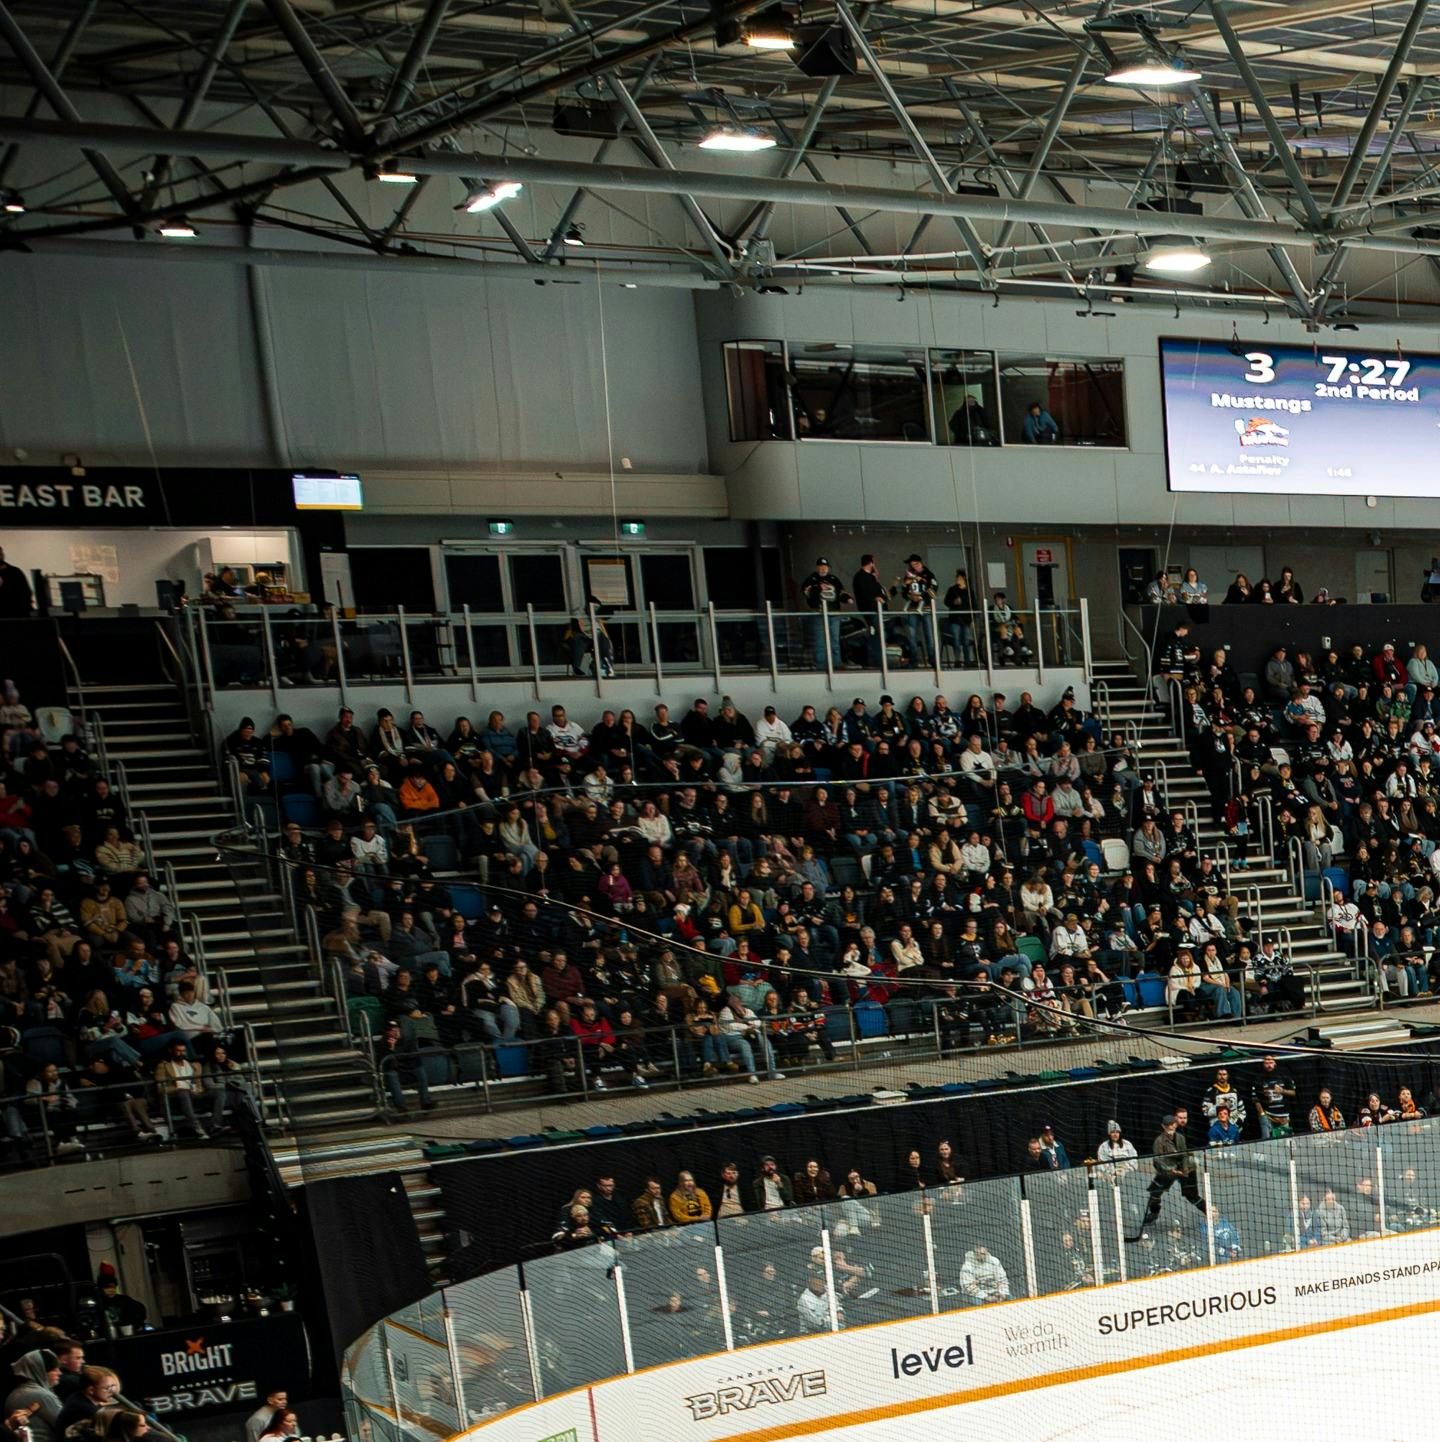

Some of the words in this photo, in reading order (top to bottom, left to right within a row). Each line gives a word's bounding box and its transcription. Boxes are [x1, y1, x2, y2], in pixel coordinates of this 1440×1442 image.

[1244, 352, 1275, 384] 3
[1322, 355, 1410, 386] 7:27
[1211, 393, 1311, 413] Mustangs
[1315, 382, 1353, 399] 2nd
[1357, 384, 1419, 402] Period
[84, 485, 145, 507] BAR
[1294, 1280, 1331, 1297] MAKE
[1332, 1271, 1381, 1291] BRANDS
[1383, 1263, 1421, 1281] STAND
[1098, 1286, 1277, 1335] SUPERCURIOUS
[1003, 1325, 1029, 1343] We
[1032, 1321, 1054, 1337] do
[1004, 1333, 1069, 1358] warmth
[161, 1343, 233, 1376] BRIGHT
[891, 1335, 974, 1379] level
[717, 1364, 795, 1383] CANBERRA
[148, 1381, 258, 1414] BRAVE
[685, 1369, 828, 1422] BRAVE
